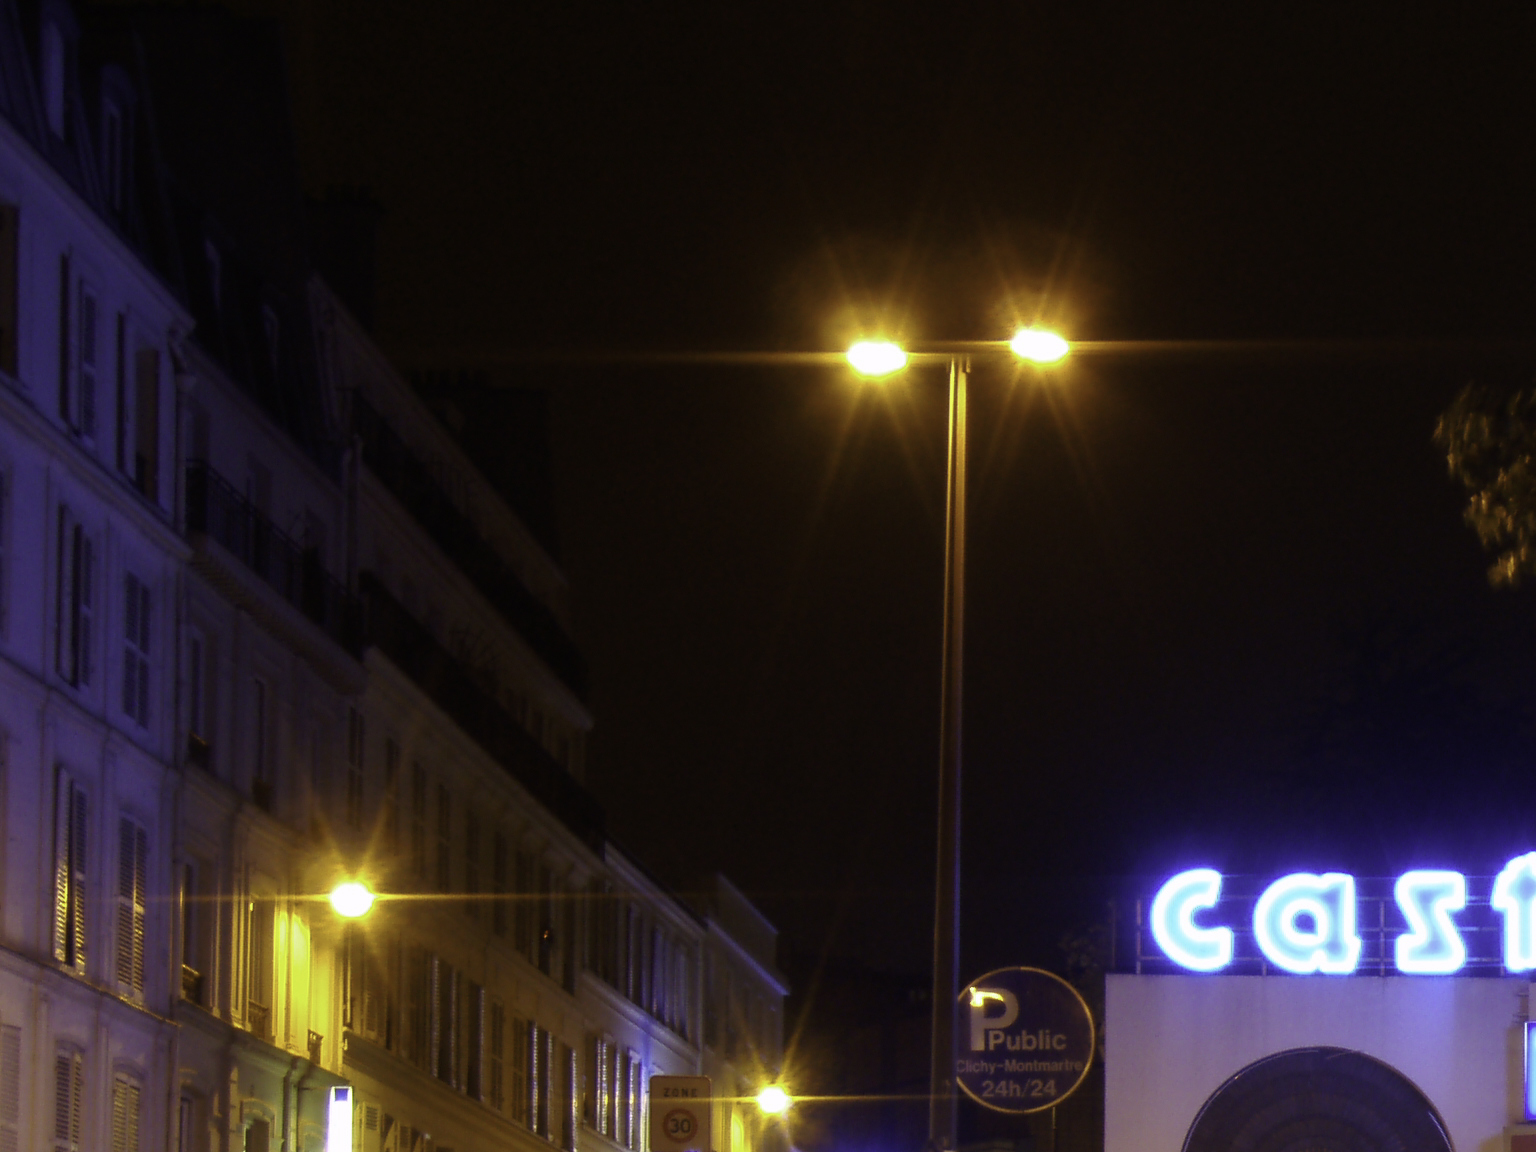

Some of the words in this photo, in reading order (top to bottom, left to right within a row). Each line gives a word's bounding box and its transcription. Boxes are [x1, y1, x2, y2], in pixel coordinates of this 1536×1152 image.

[970, 987, 1019, 1051] P
[988, 1030, 1067, 1051] Public
[956, 1058, 1084, 1074] Clichy-Montmartre
[663, 1088, 698, 1098] ZONE
[982, 1079, 1057, 1098] 24h/24
[669, 1118, 691, 1134] 30
